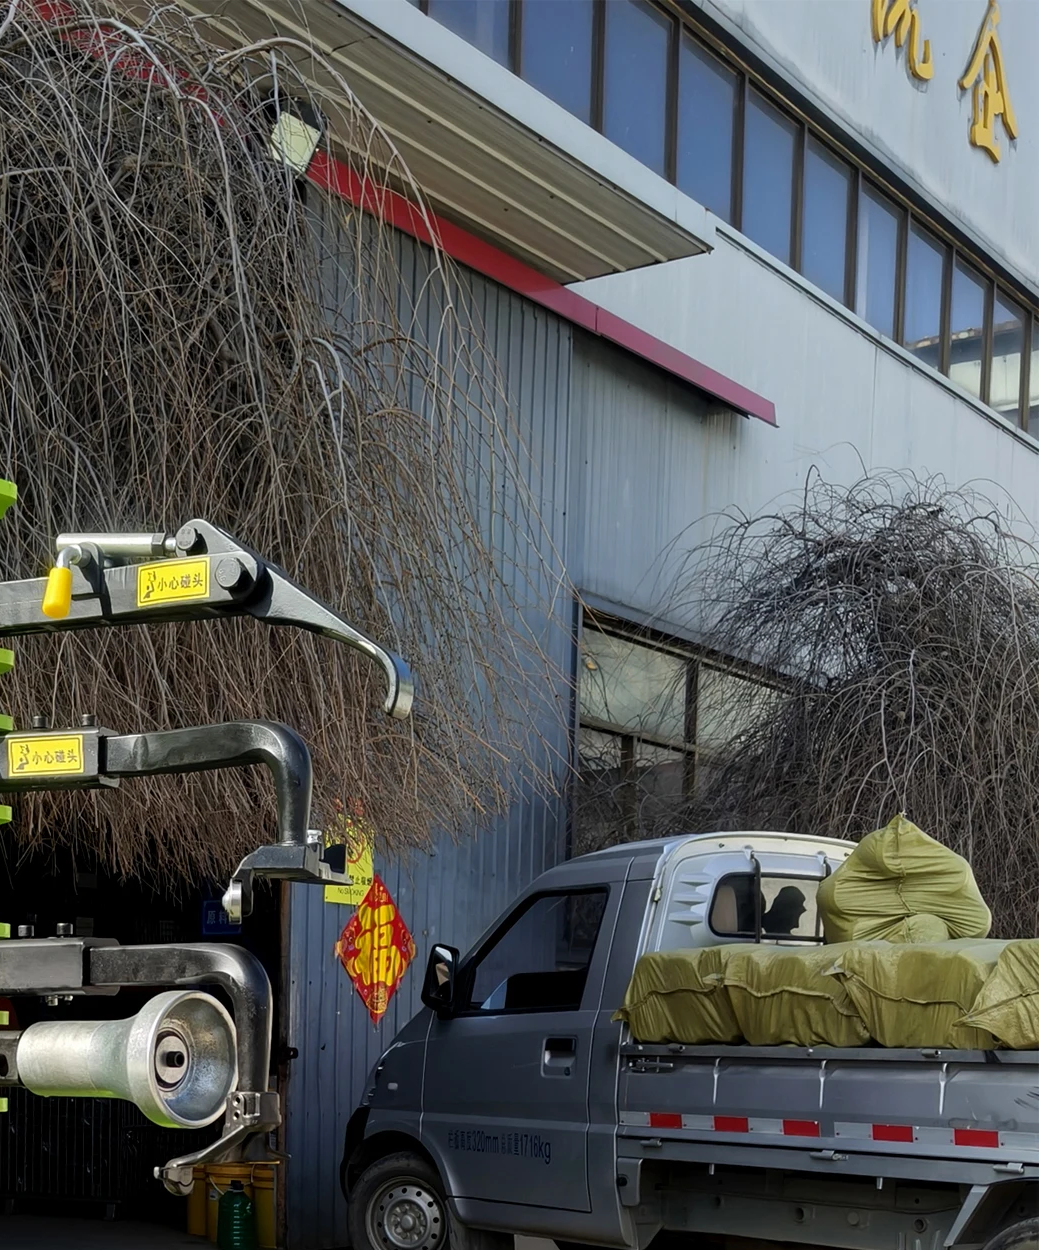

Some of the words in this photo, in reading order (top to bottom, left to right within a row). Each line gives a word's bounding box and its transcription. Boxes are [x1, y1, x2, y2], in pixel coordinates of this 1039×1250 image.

[157, 573, 203, 592] 小心碰头
[32, 749, 78, 765] 小心碰头
[354, 903, 401, 987] 福
